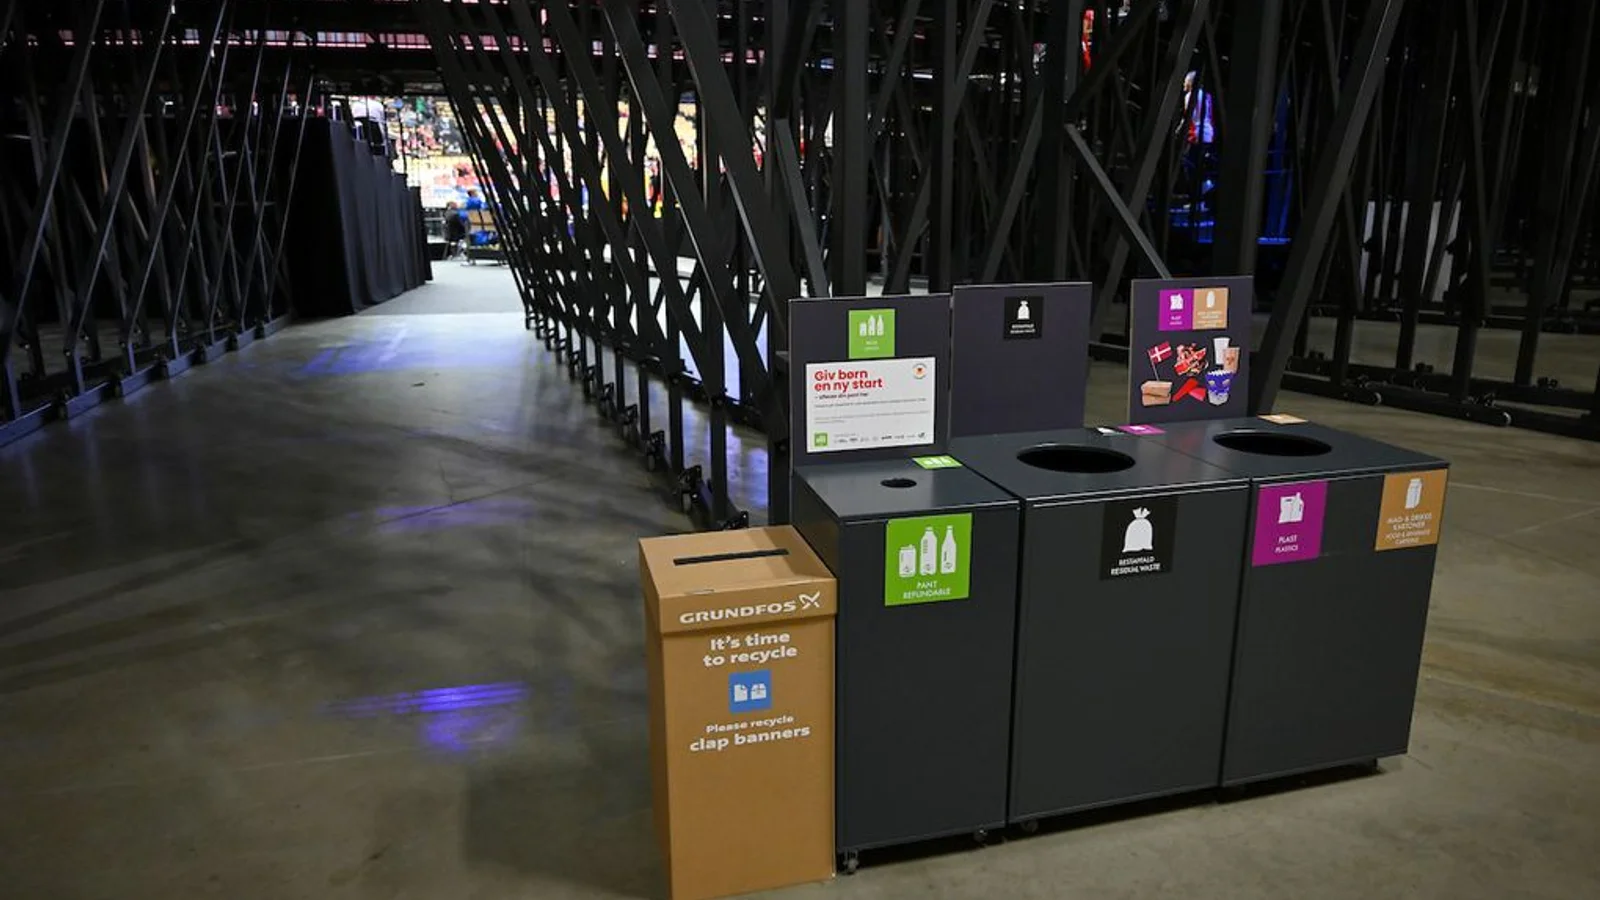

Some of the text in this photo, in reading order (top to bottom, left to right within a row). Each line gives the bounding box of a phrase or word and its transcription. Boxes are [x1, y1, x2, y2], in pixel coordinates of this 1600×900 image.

[814, 369, 868, 381] Giv børn
[814, 378, 883, 393] en ny start
[1278, 534, 1298, 544] PLAST
[1274, 544, 1299, 554] PLASTICS
[1110, 562, 1161, 576] RESIDUAL WASTE
[916, 580, 938, 589] PANT
[903, 587, 952, 599] REFUNDABLE
[679, 601, 797, 624] GRUNDFOS
[745, 632, 791, 646] time
[703, 645, 798, 667] to recycle
[706, 715, 795, 733] Please recycle
[689, 725, 811, 752] clap banners
